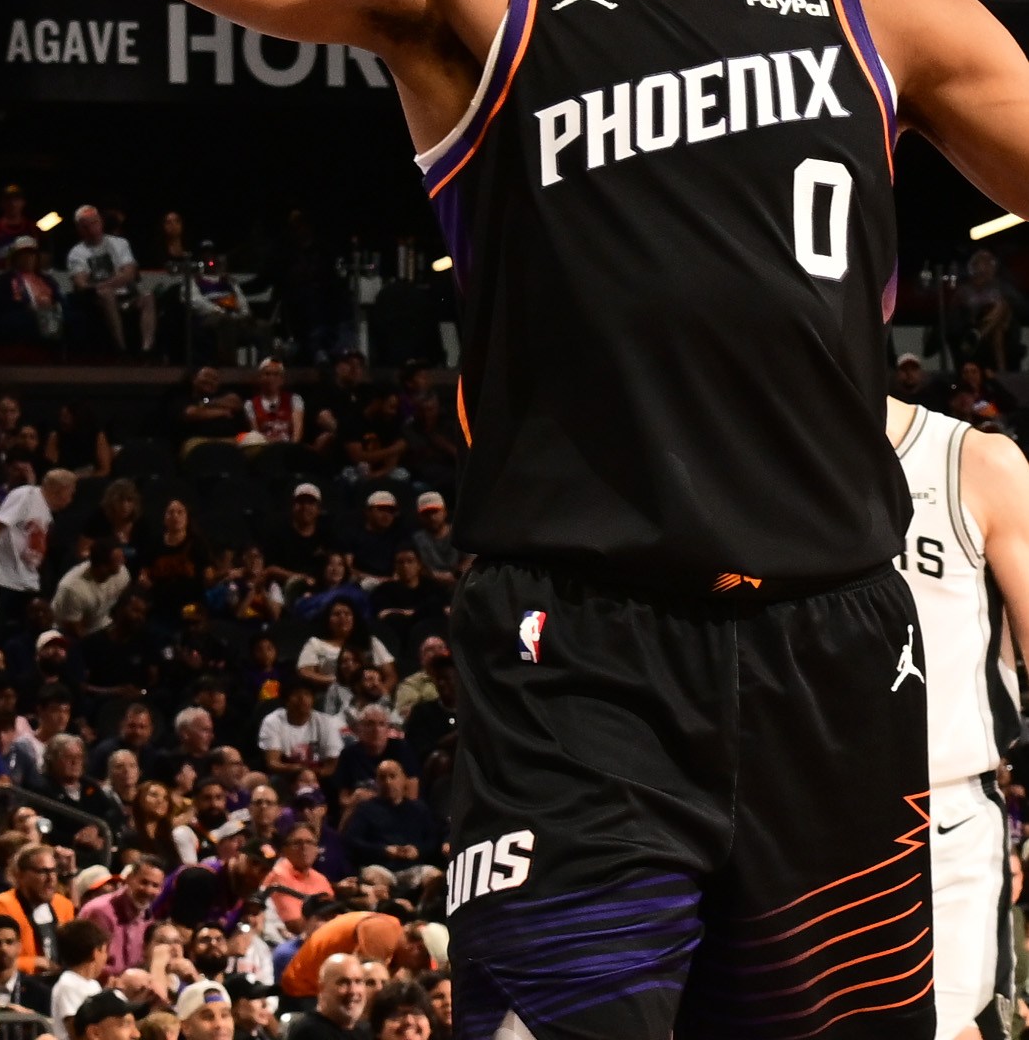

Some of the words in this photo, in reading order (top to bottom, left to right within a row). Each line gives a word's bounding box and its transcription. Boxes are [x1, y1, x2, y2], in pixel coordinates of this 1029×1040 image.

[7, 18, 140, 66] AGAVE
[533, 44, 852, 188] PHOENIX
[791, 157, 854, 281] 0
[446, 829, 535, 918] UNS
